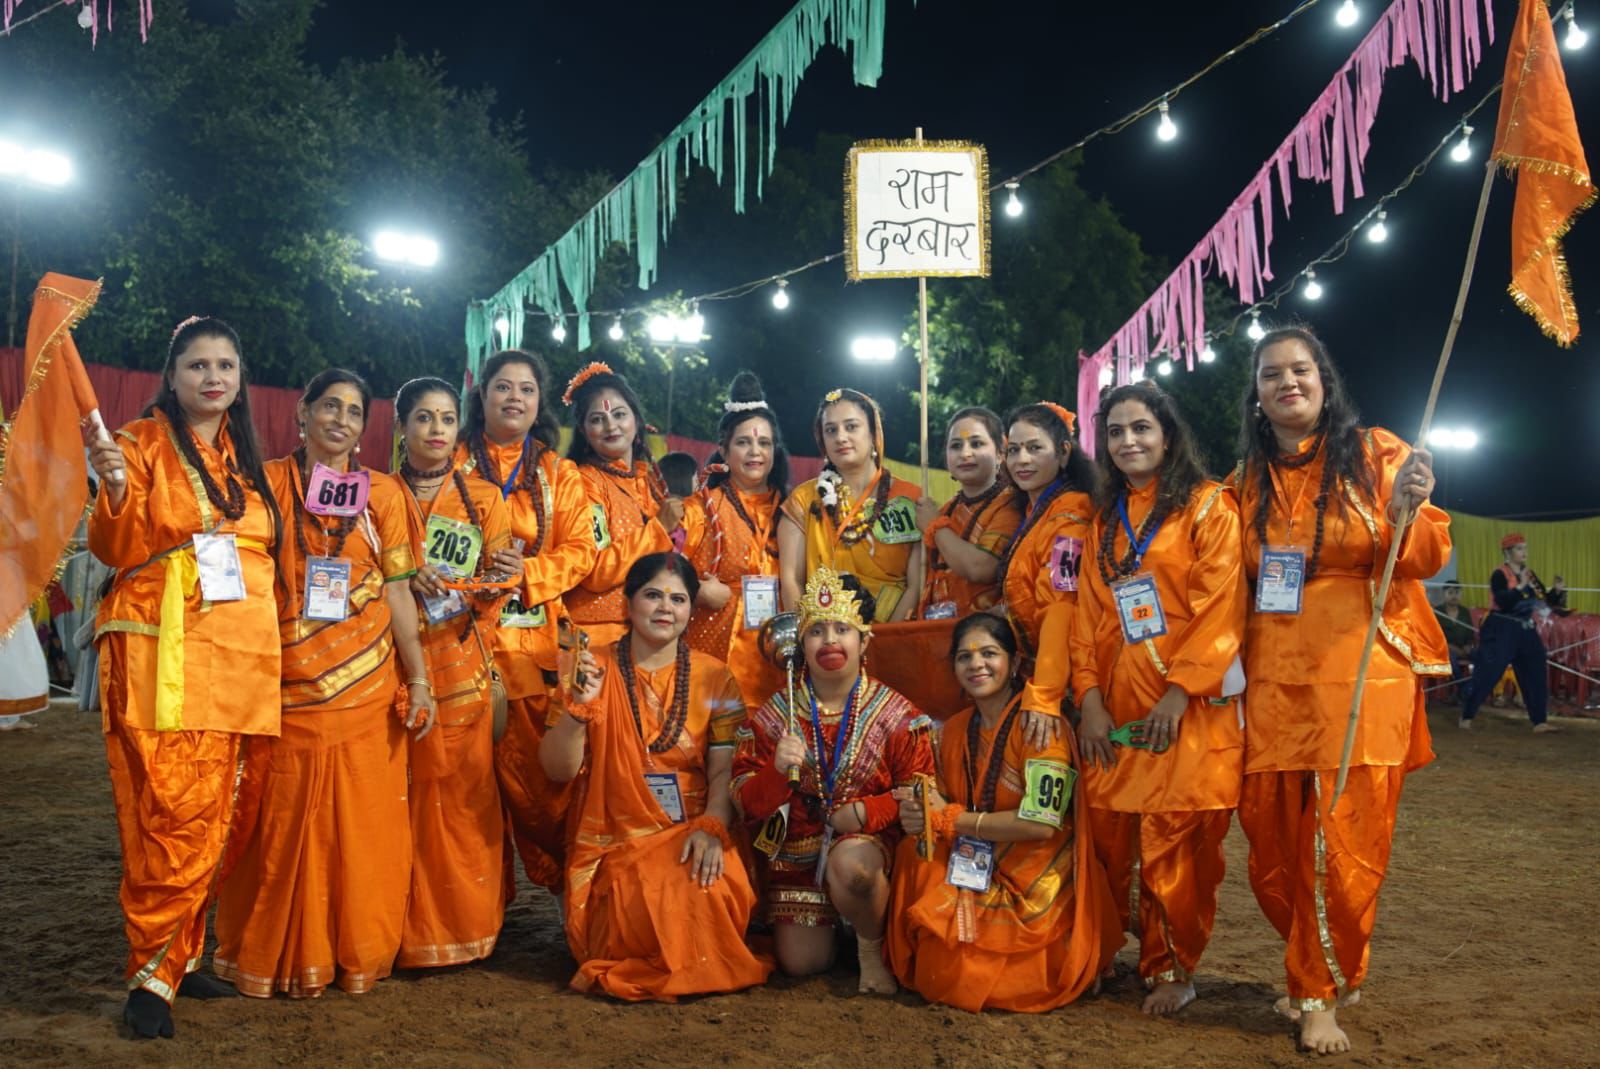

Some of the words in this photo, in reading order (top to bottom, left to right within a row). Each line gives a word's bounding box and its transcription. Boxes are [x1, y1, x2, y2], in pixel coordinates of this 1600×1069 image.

[888, 168, 963, 213] राम
[866, 217, 976, 265] दरबार
[318, 479, 359, 507] 681
[429, 529, 472, 566] 203
[1136, 607, 1148, 618] 22
[1038, 774, 1064, 812] 93
